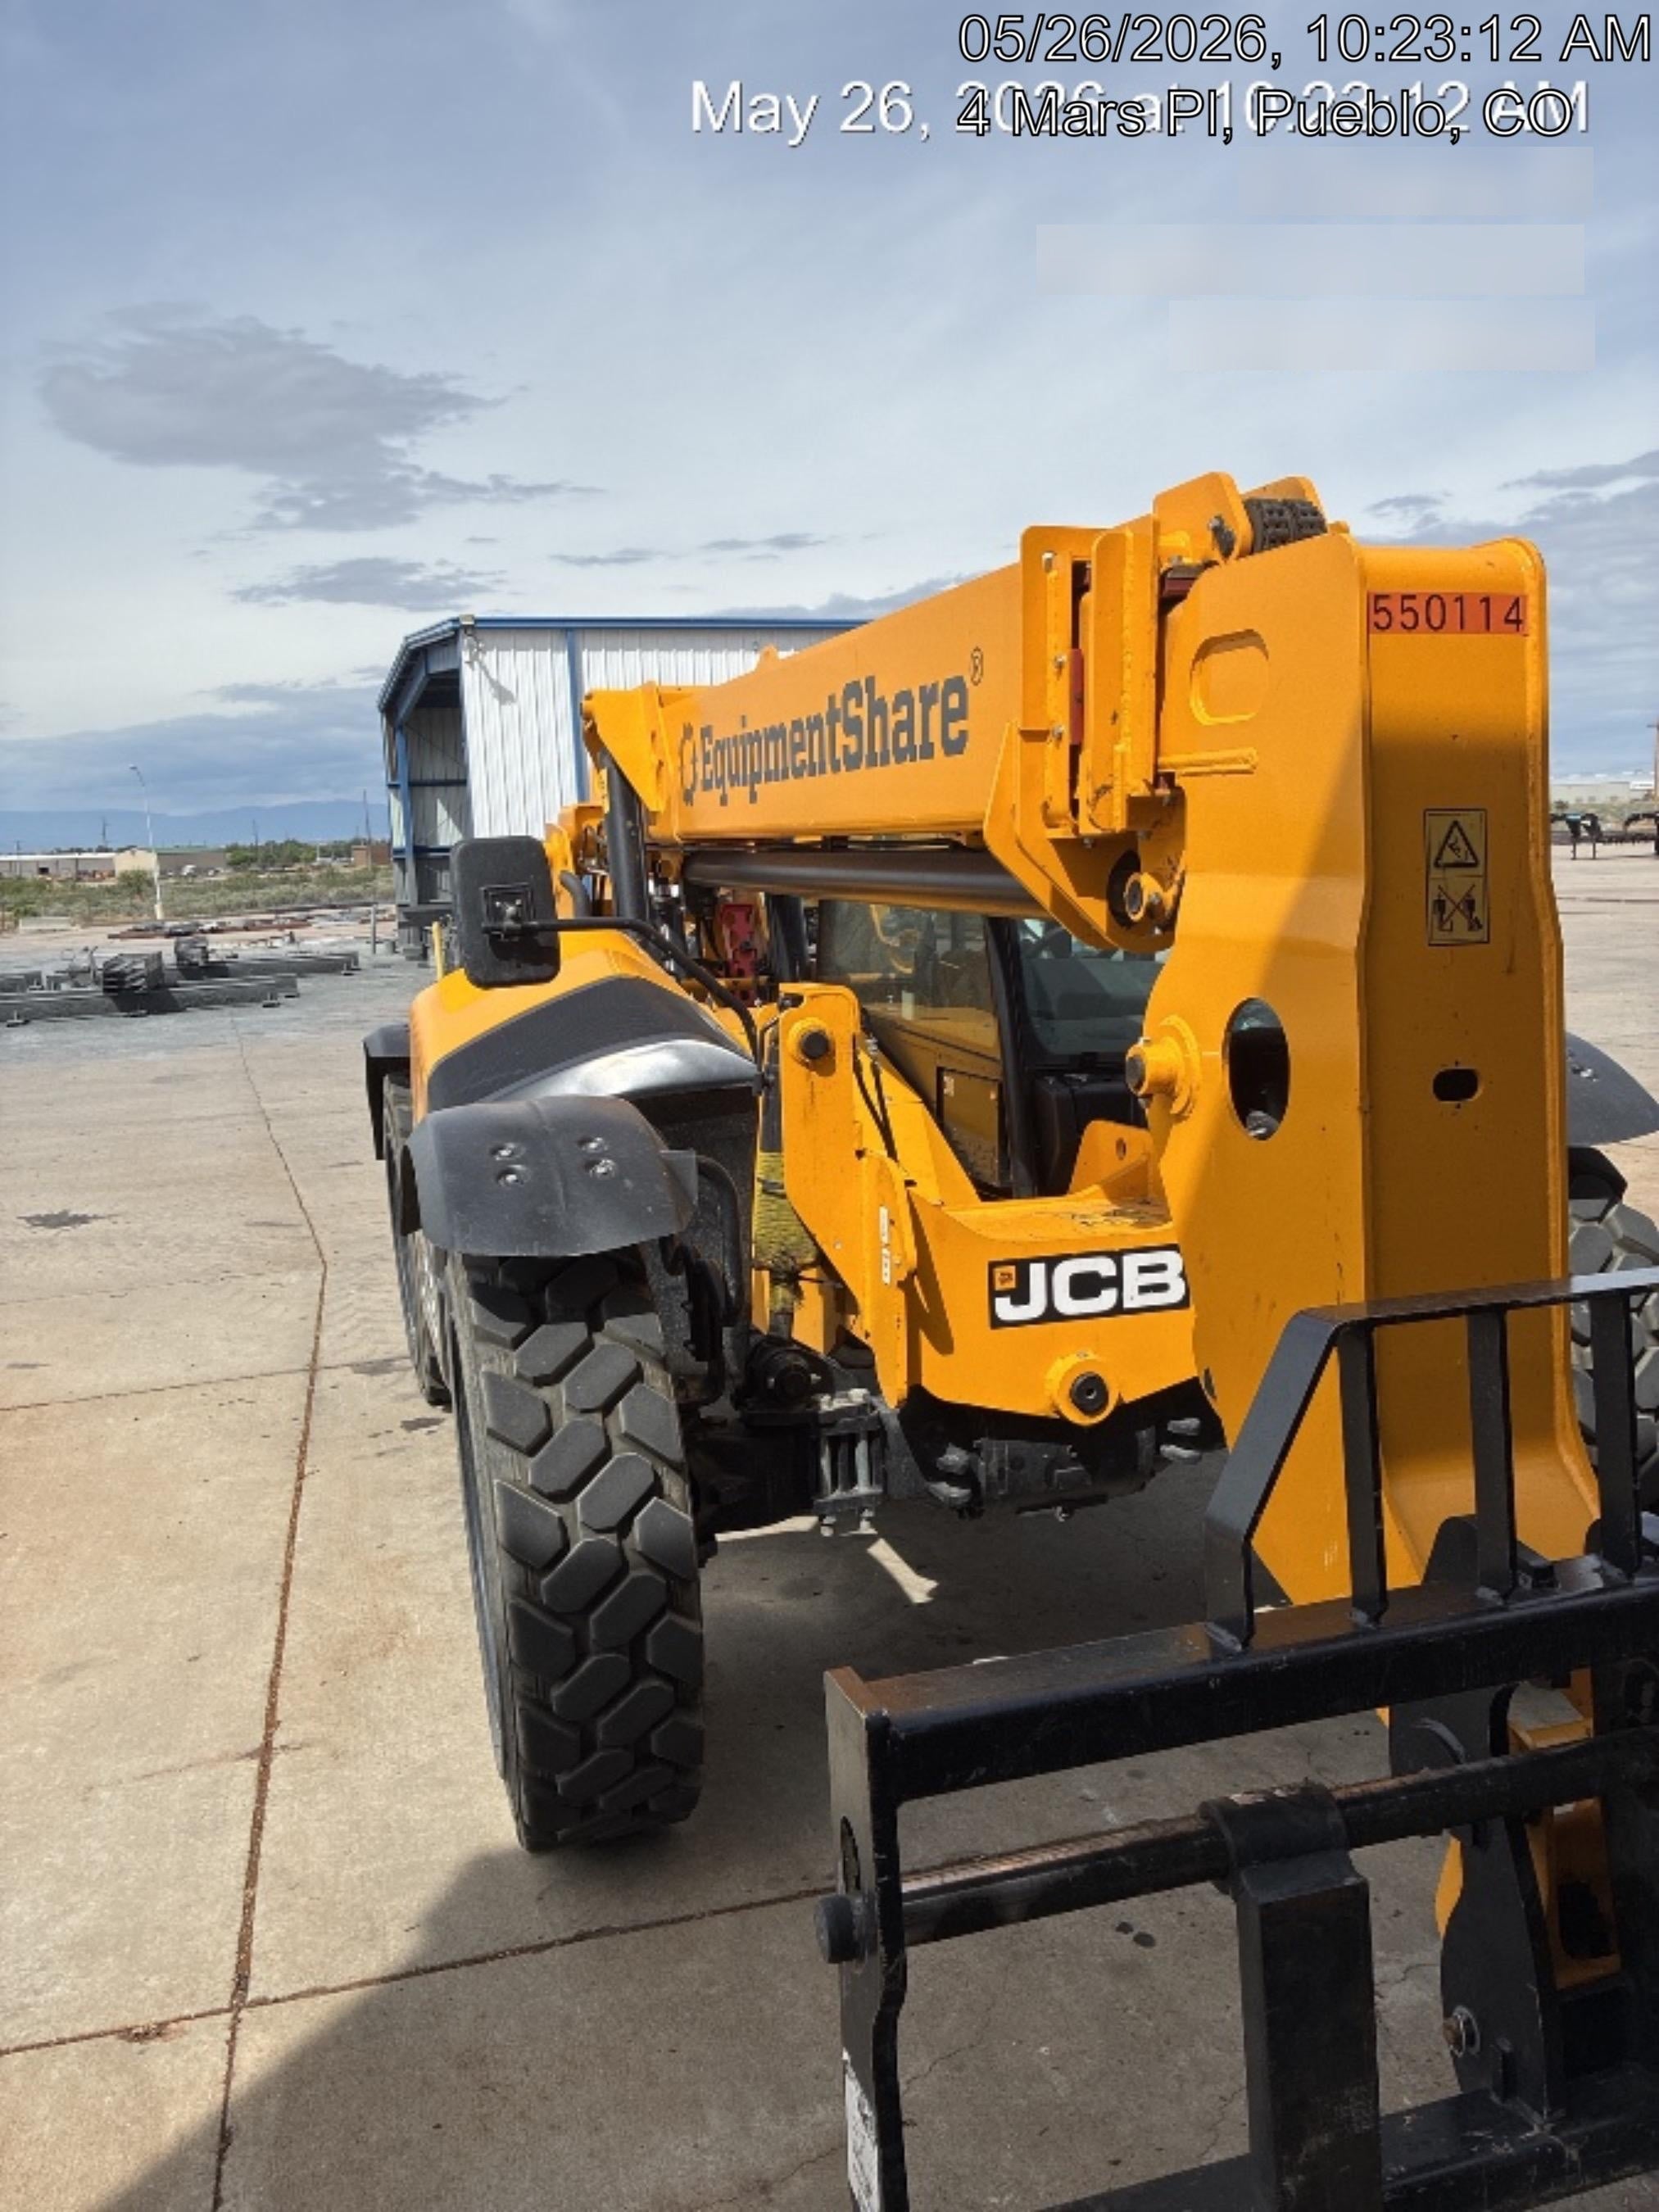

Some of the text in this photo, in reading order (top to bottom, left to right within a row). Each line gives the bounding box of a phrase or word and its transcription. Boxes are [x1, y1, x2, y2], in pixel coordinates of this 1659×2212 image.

[1373, 594, 1524, 632] 550114
[700, 675, 969, 806] EquipmentShare
[995, 1250, 1185, 1321] JCB
